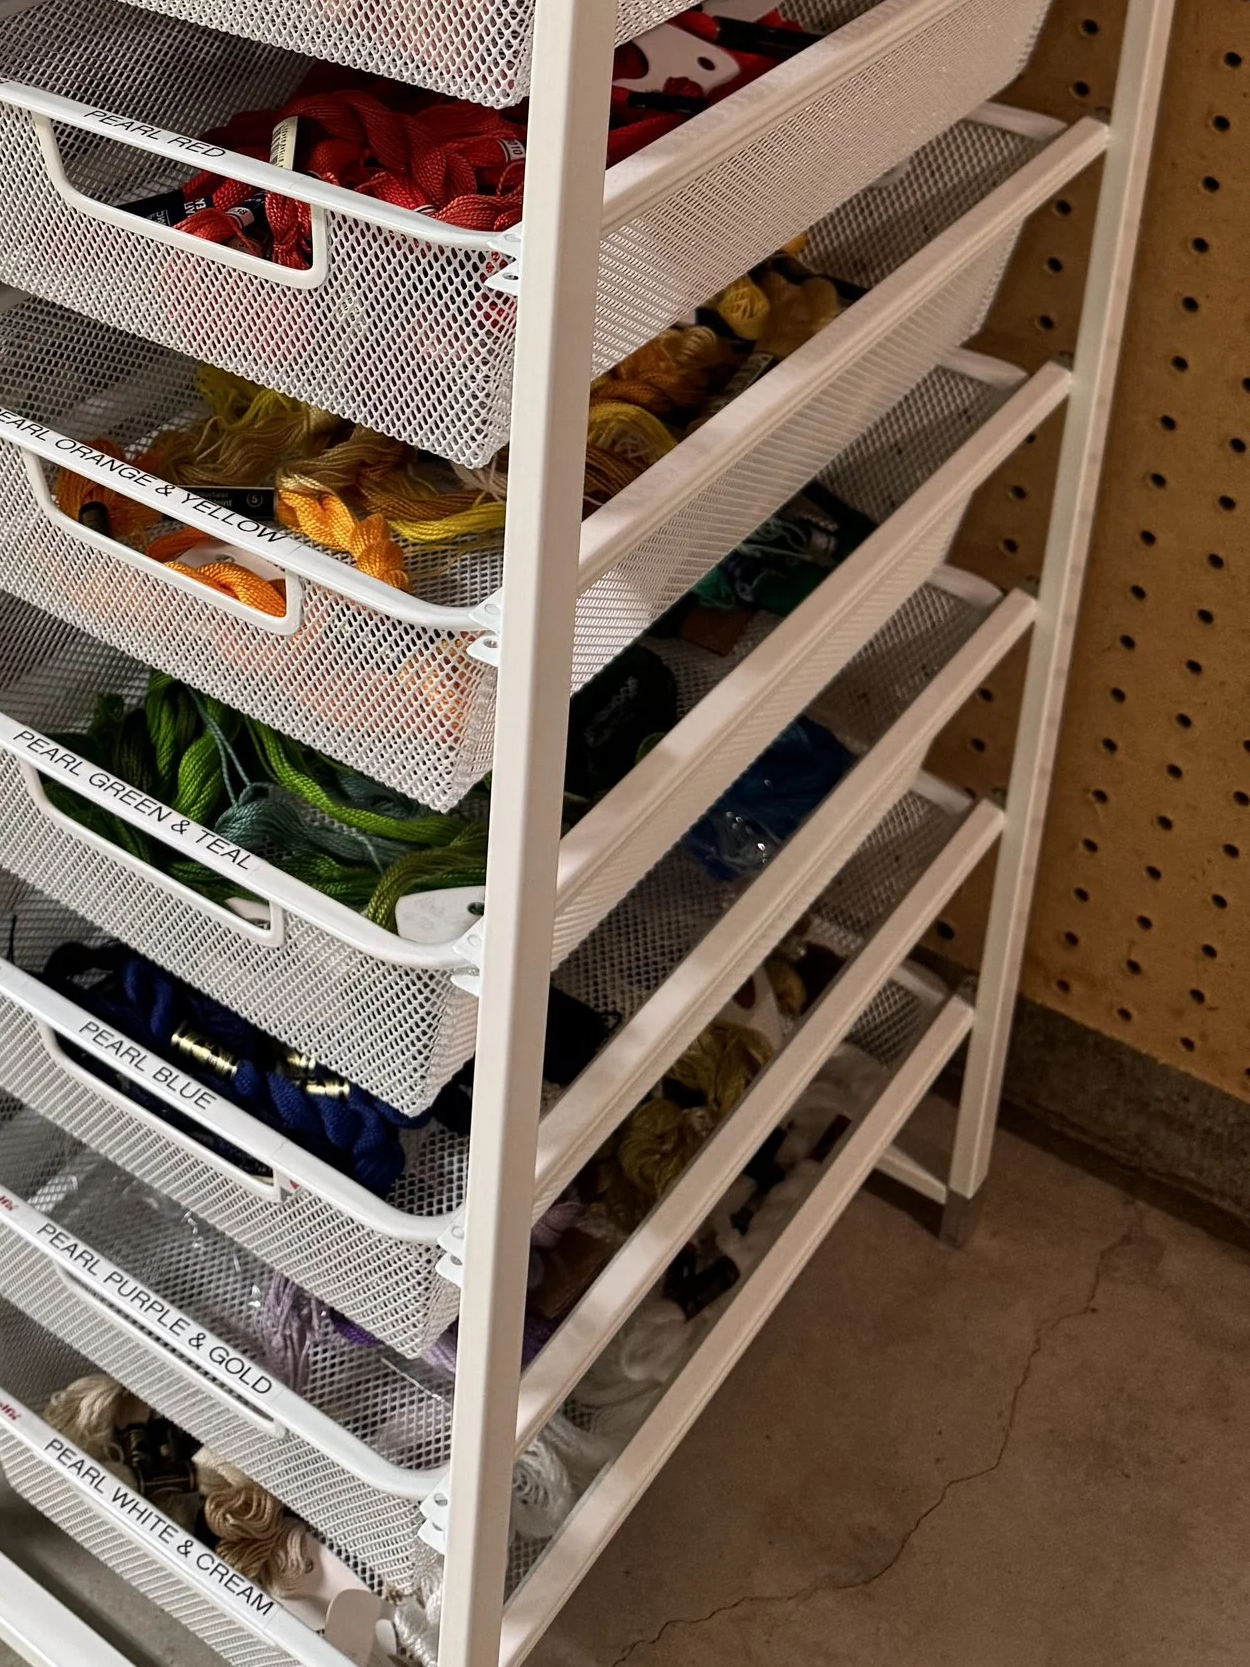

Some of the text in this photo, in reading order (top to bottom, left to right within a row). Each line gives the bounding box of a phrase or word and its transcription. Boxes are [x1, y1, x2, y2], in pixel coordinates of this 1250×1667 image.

[83, 110, 227, 159] PEARL RED
[55, 438, 158, 487] ORANGE
[155, 484, 177, 497] &
[181, 492, 287, 543] YELLOW
[13, 730, 255, 870] PEARL GREEN & TEAL
[79, 1021, 217, 1110] PEARL BLUE
[36, 1223, 272, 1395] PEARL PURPLE & GOLD
[44, 1438, 275, 1616] PEARL WHITE & CREAM
